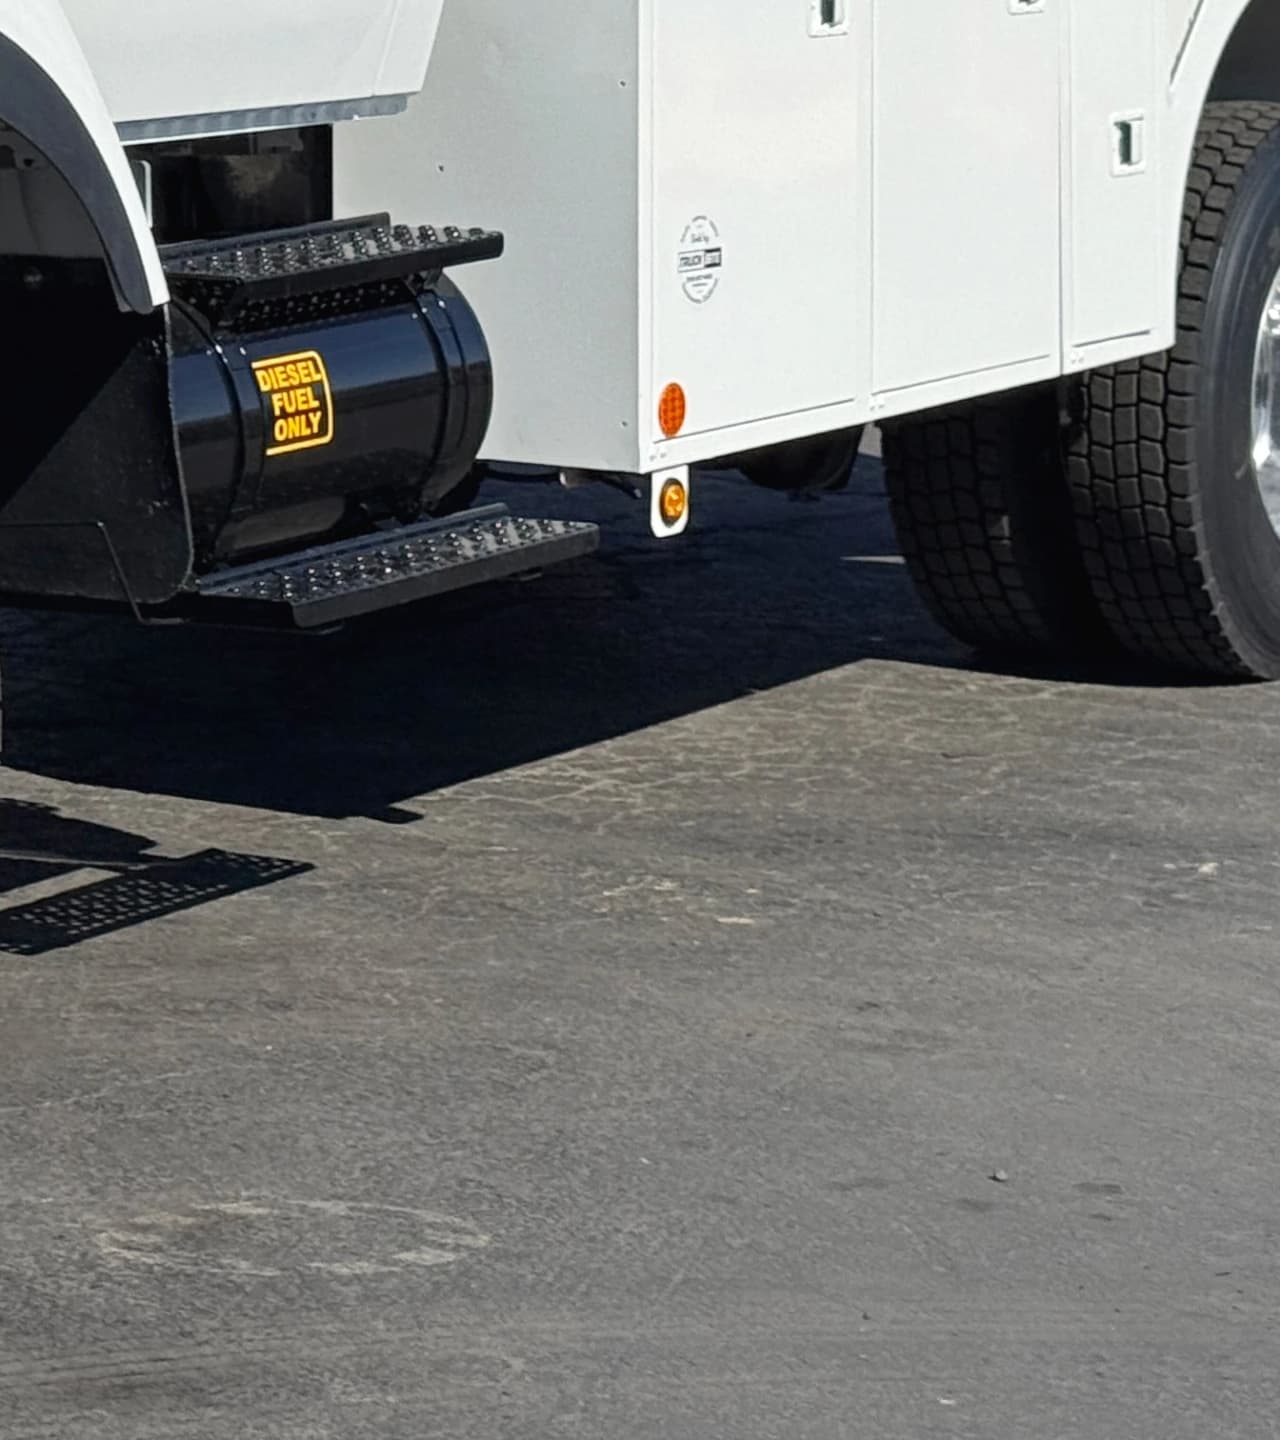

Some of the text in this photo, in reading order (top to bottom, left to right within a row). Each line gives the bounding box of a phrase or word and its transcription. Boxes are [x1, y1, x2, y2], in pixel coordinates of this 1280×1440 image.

[255, 360, 322, 393] DIESEL
[271, 386, 320, 417] FUEL
[274, 411, 322, 442] ONLY
